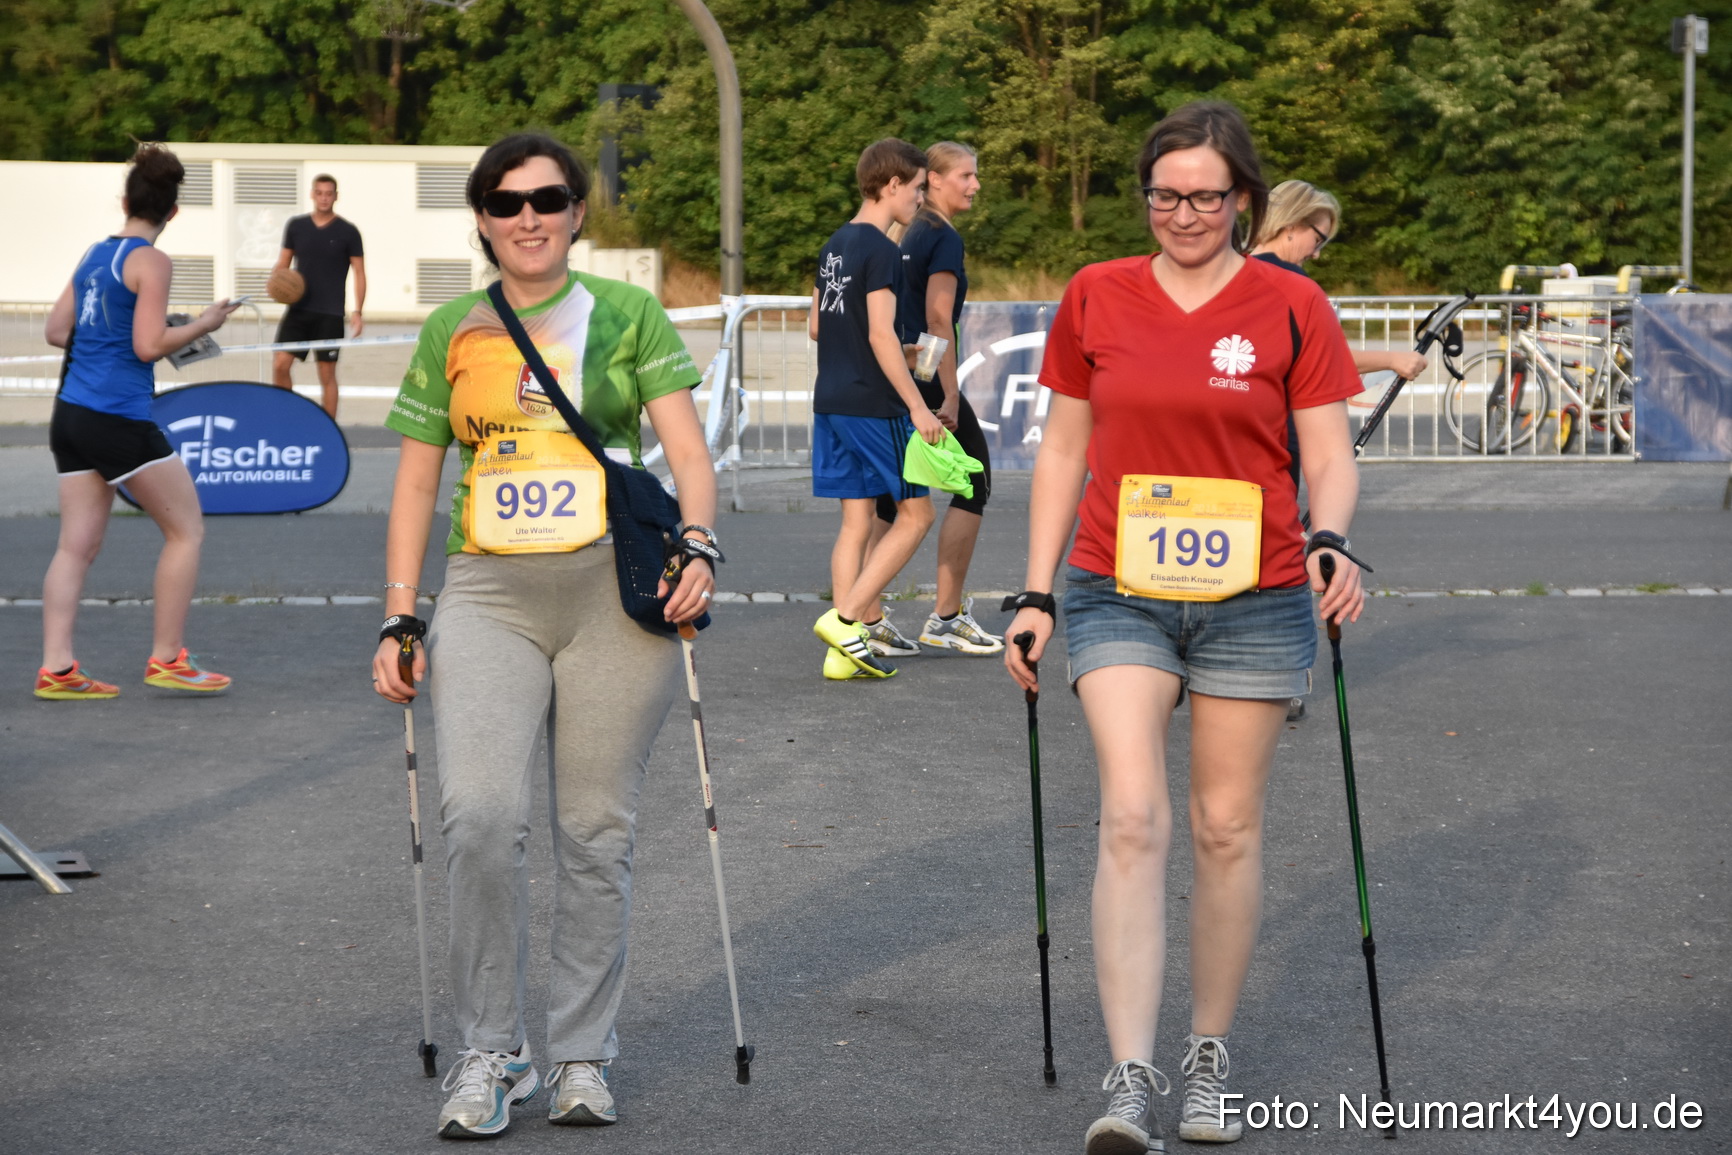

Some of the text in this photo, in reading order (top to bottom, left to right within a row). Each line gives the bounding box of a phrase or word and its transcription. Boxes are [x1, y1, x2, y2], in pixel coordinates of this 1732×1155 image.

[1209, 376, 1250, 391] caritas
[400, 393, 427, 411] Genuss
[526, 402, 546, 414] 1628
[391, 402, 426, 423] sbraeu.de
[180, 439, 321, 468] Fischer
[195, 469, 312, 483] AUTOMOBILE
[477, 466, 512, 478] walken
[495, 480, 577, 520] 992
[1127, 509, 1167, 520] walken
[530, 526, 557, 535] Walter
[1149, 526, 1230, 568] 199
[1150, 573, 1224, 586] Elisabeth Knaupp
